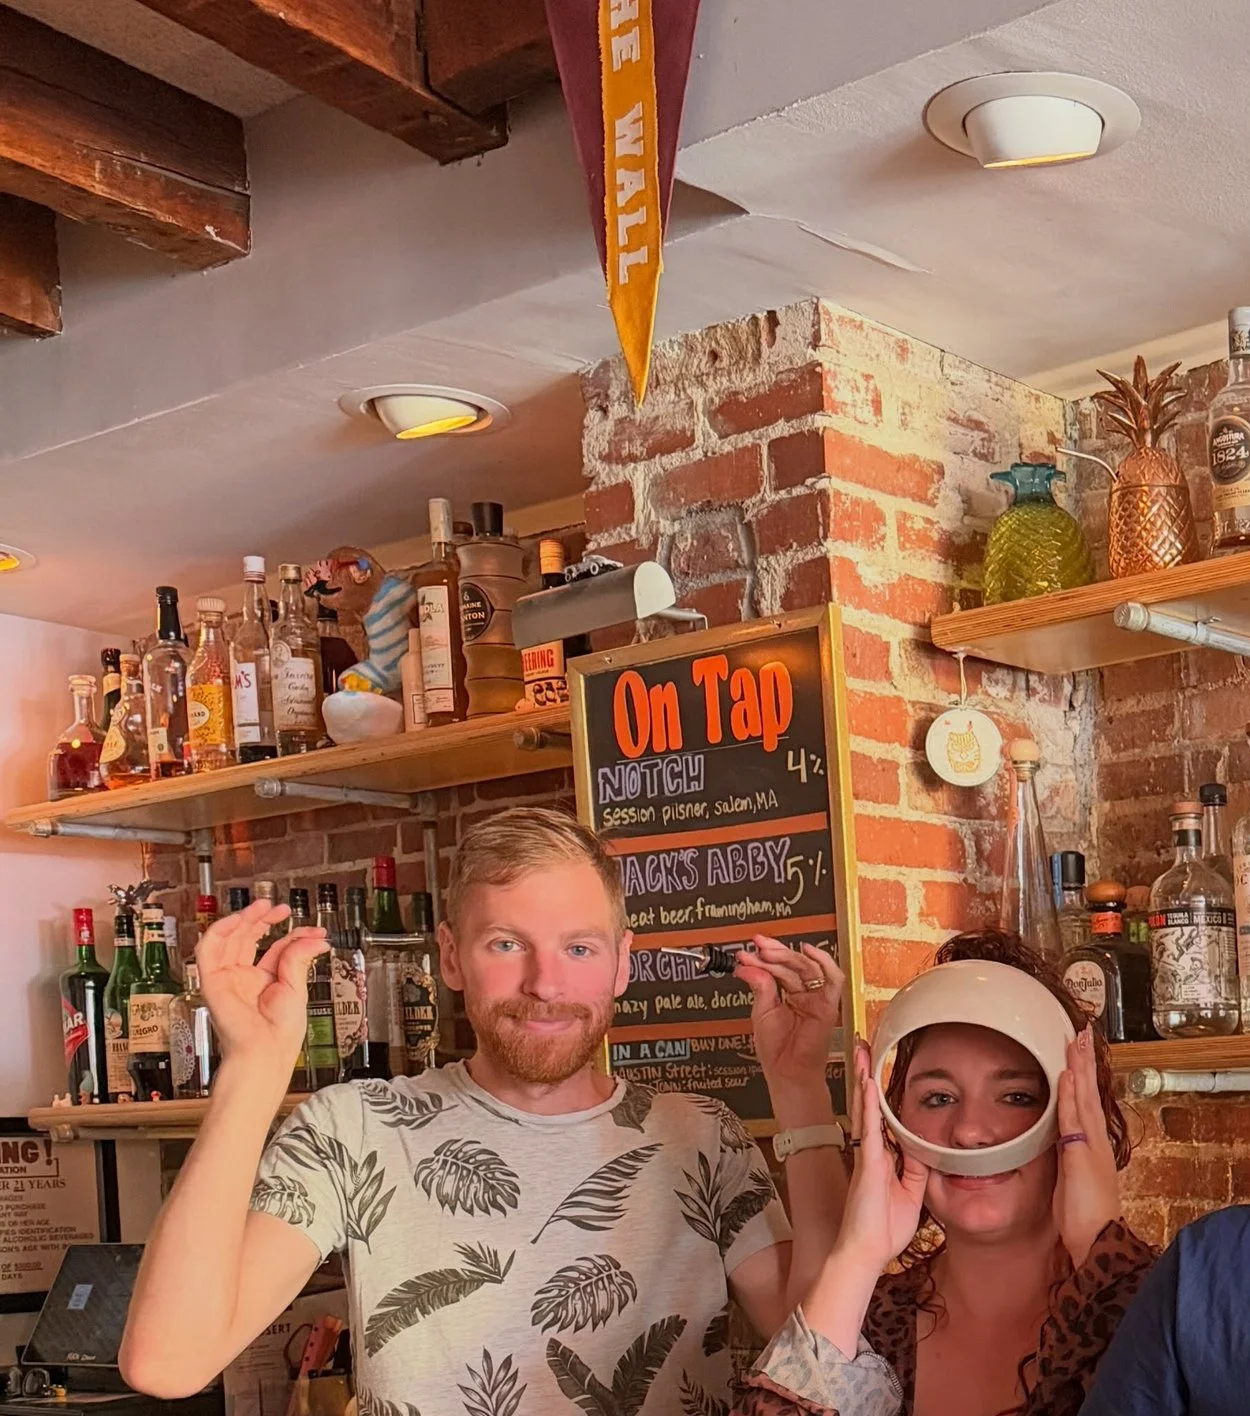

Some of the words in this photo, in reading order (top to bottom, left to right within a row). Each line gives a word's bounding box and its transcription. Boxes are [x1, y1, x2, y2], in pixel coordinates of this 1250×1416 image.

[614, 101, 649, 285] WALL
[1212, 446, 1250, 467] 1824
[613, 669, 683, 759] On
[692, 653, 794, 753] Tap
[598, 754, 705, 805] NOTCH
[787, 748, 825, 783] 4%
[602, 805, 656, 827] session
[662, 800, 710, 826] pilsner,
[707, 836, 792, 887] ABBY
[1167, 918, 1189, 926] BLANCO
[1193, 914, 1222, 926] MEXICO
[654, 992, 683, 1014] pale
[686, 994, 709, 1011] ale,
[612, 1045, 631, 1060] IN
[640, 1043, 651, 1058] A
[655, 1039, 687, 1058] CAN
[691, 1038, 716, 1052] BUY
[724, 1075, 750, 1088] sour
[14, 1180, 24, 1190] 21
[28, 1178, 67, 1190] YEARS
[3, 1233, 46, 1242] ALCOHOLIC
[19, 1226, 76, 1235] IDENTIFICATION
